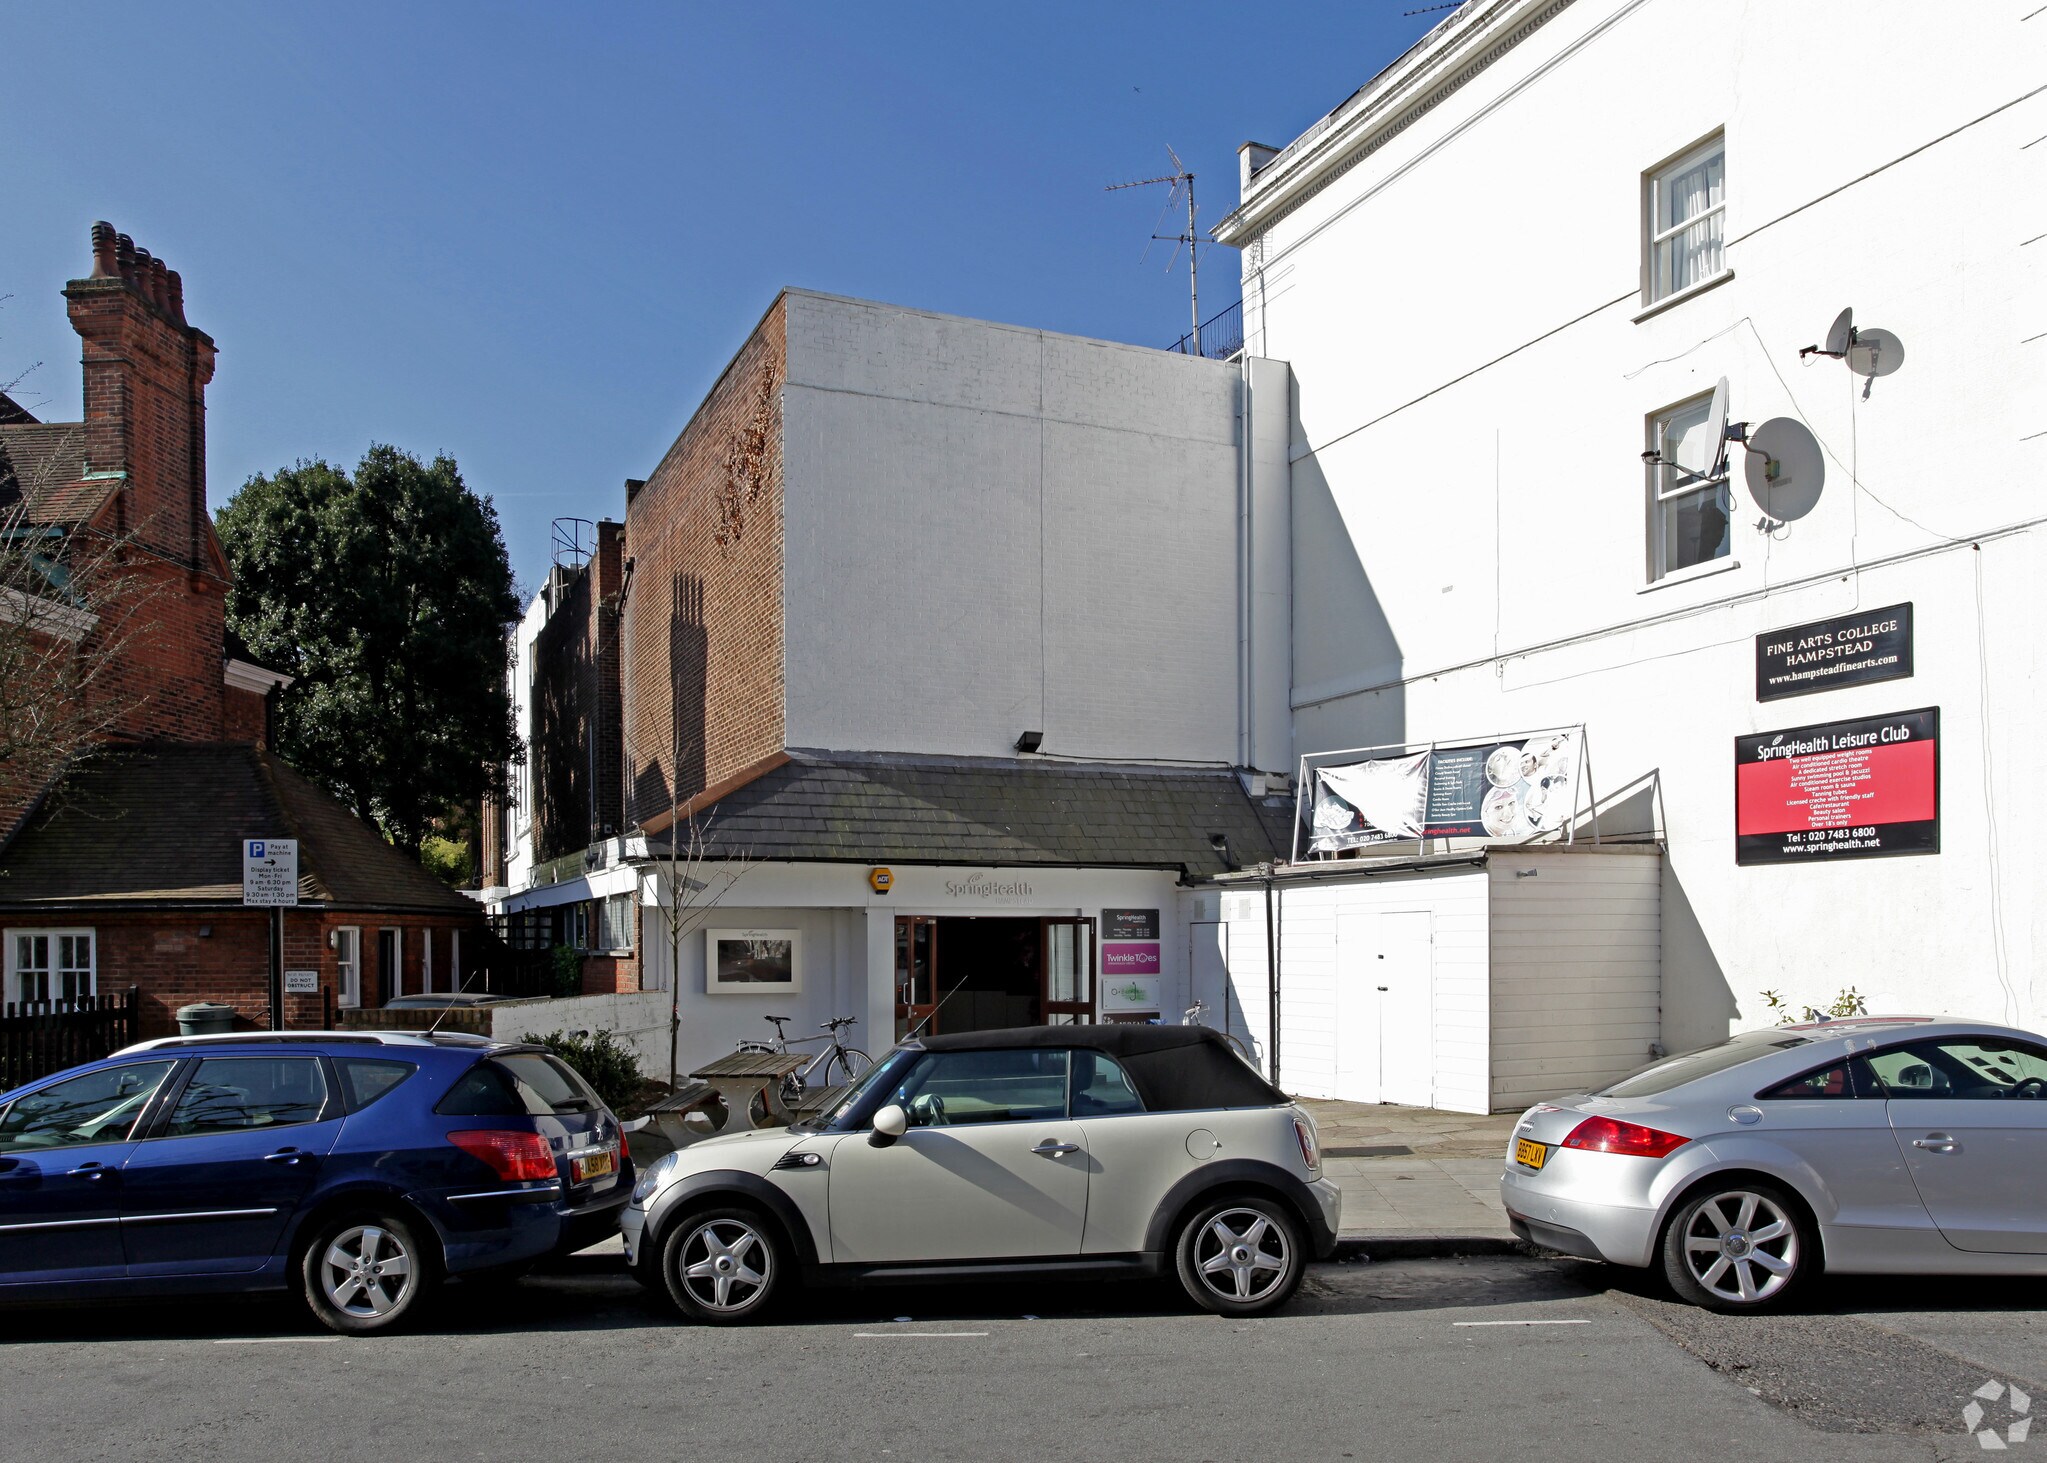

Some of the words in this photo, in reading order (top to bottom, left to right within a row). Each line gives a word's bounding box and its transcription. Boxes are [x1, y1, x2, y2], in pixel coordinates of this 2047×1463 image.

[1767, 642, 1794, 656] FINE
[1798, 634, 1832, 650] ARTS
[1838, 620, 1897, 641] COLLEGE
[1787, 641, 1872, 666] HAMPSTEAD
[1769, 655, 1897, 684] www.hampsteadfinearts.com
[1758, 736, 1828, 762] SpringHealth
[1833, 732, 1877, 749] Leisure
[1881, 724, 1909, 742] Club
[1812, 753, 1835, 762] equipped
[1787, 833, 1800, 842] Tel
[1808, 832, 1825, 841] 020
[1828, 829, 1849, 839] 7483
[1852, 827, 1875, 837] 6800
[253, 844, 262, 856] P
[1783, 838, 1880, 853] www.springhealth.net
[946, 882, 1033, 897] SpringHealth
